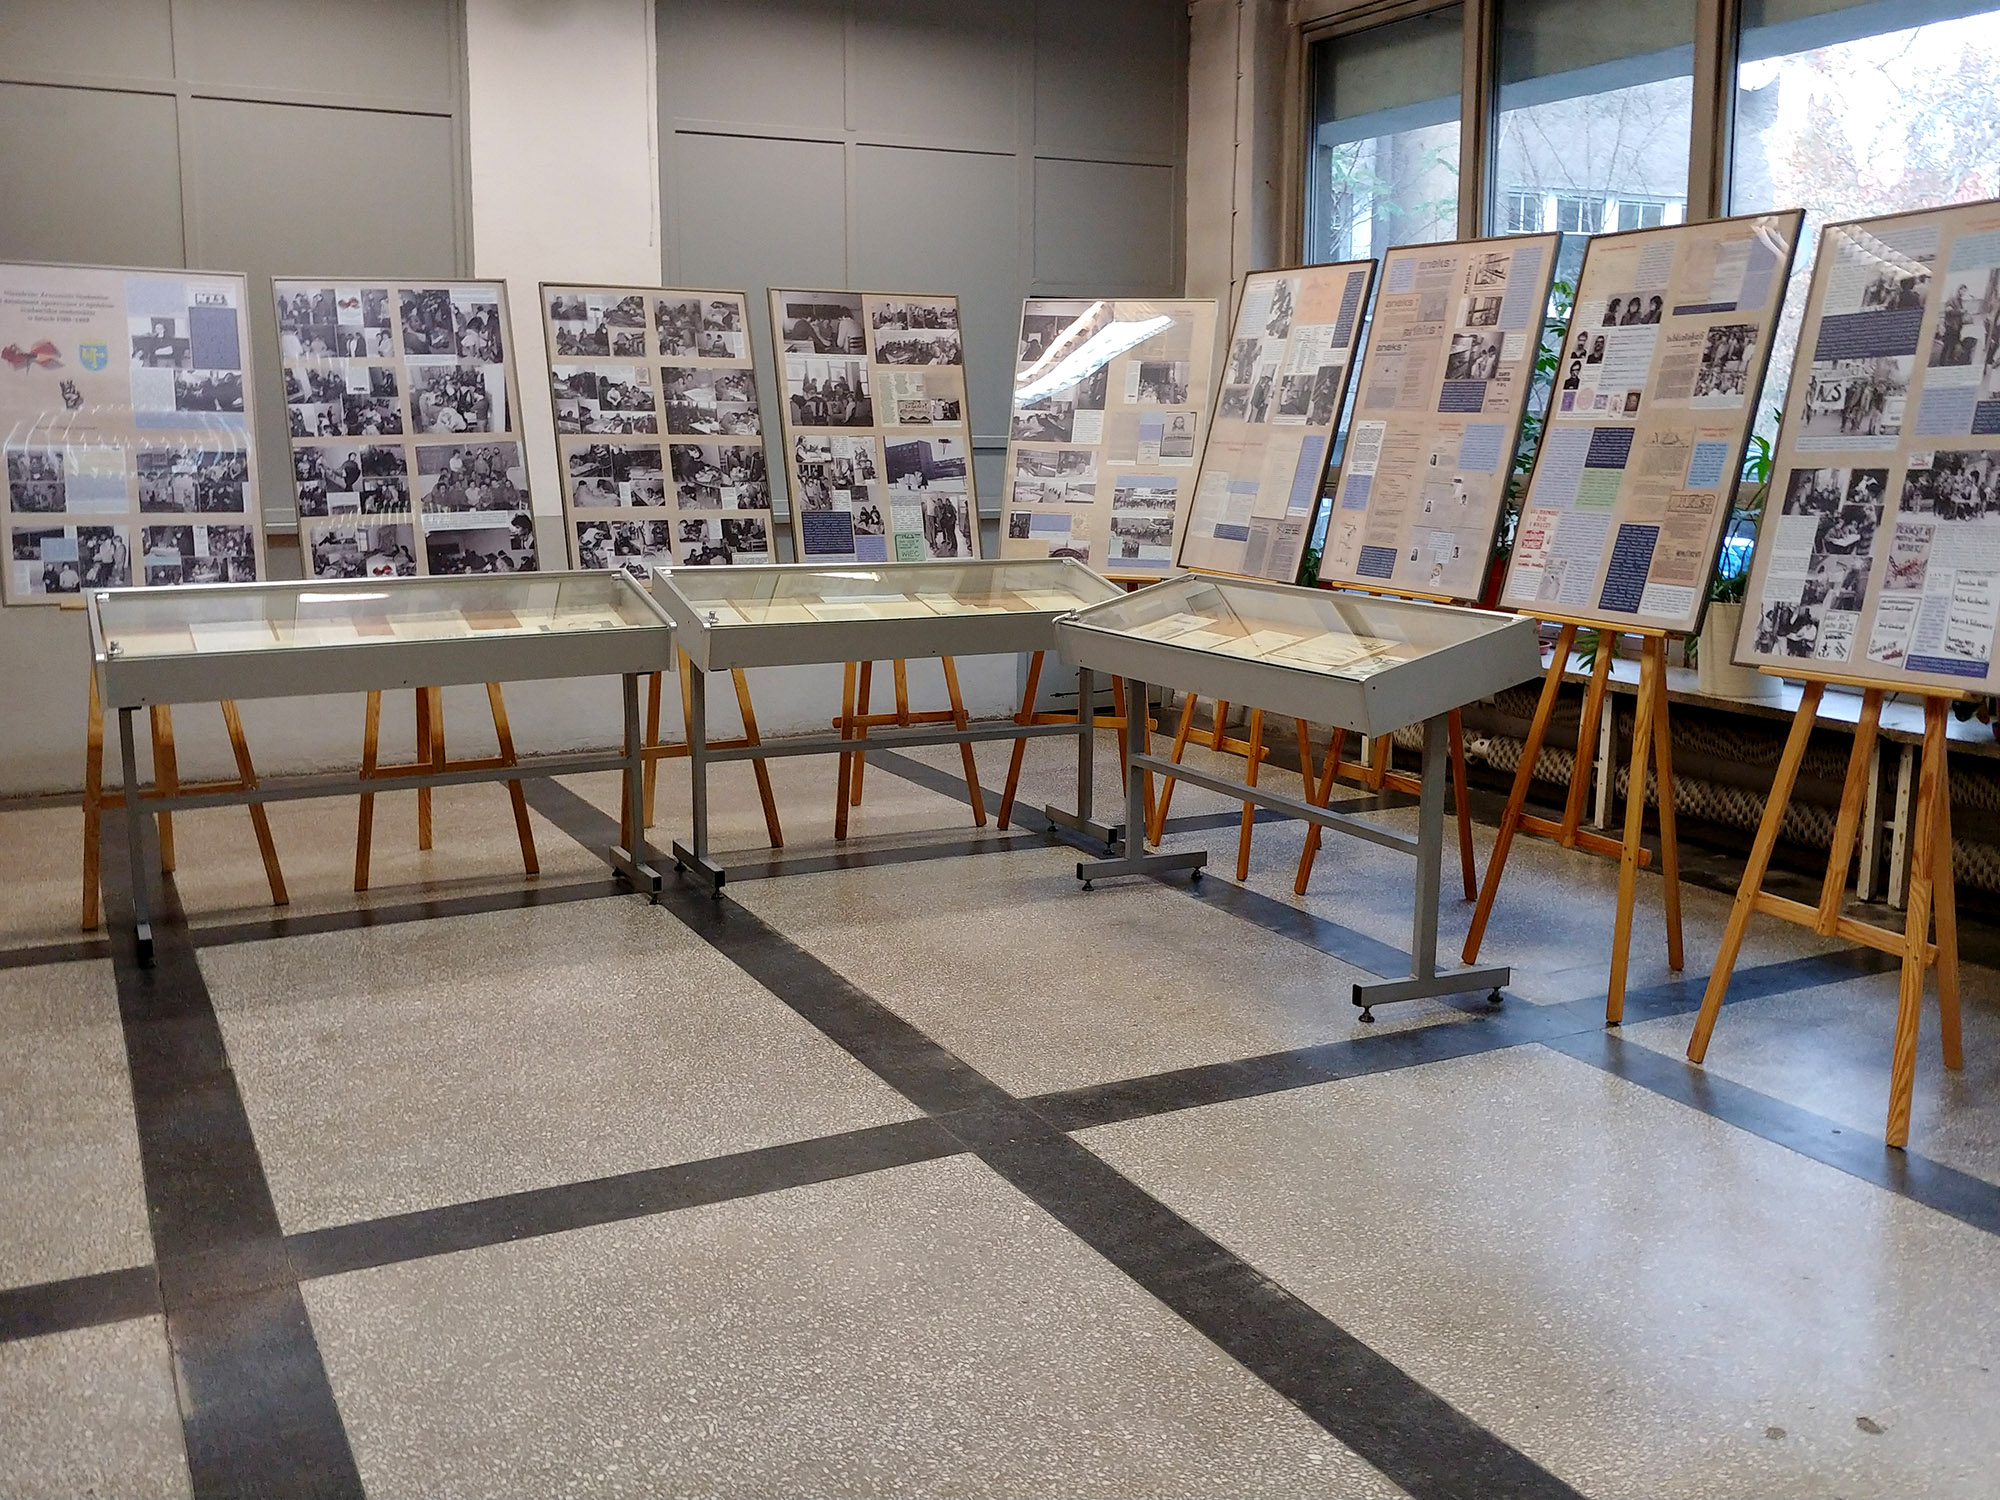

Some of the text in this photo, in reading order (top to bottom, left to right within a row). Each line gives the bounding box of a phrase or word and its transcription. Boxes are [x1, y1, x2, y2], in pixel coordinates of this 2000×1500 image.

[1418, 259, 1450, 270] aneks
[1385, 298, 1415, 308] aneks
[1375, 343, 1403, 352] aneks
[902, 550, 921, 558] WIEC
